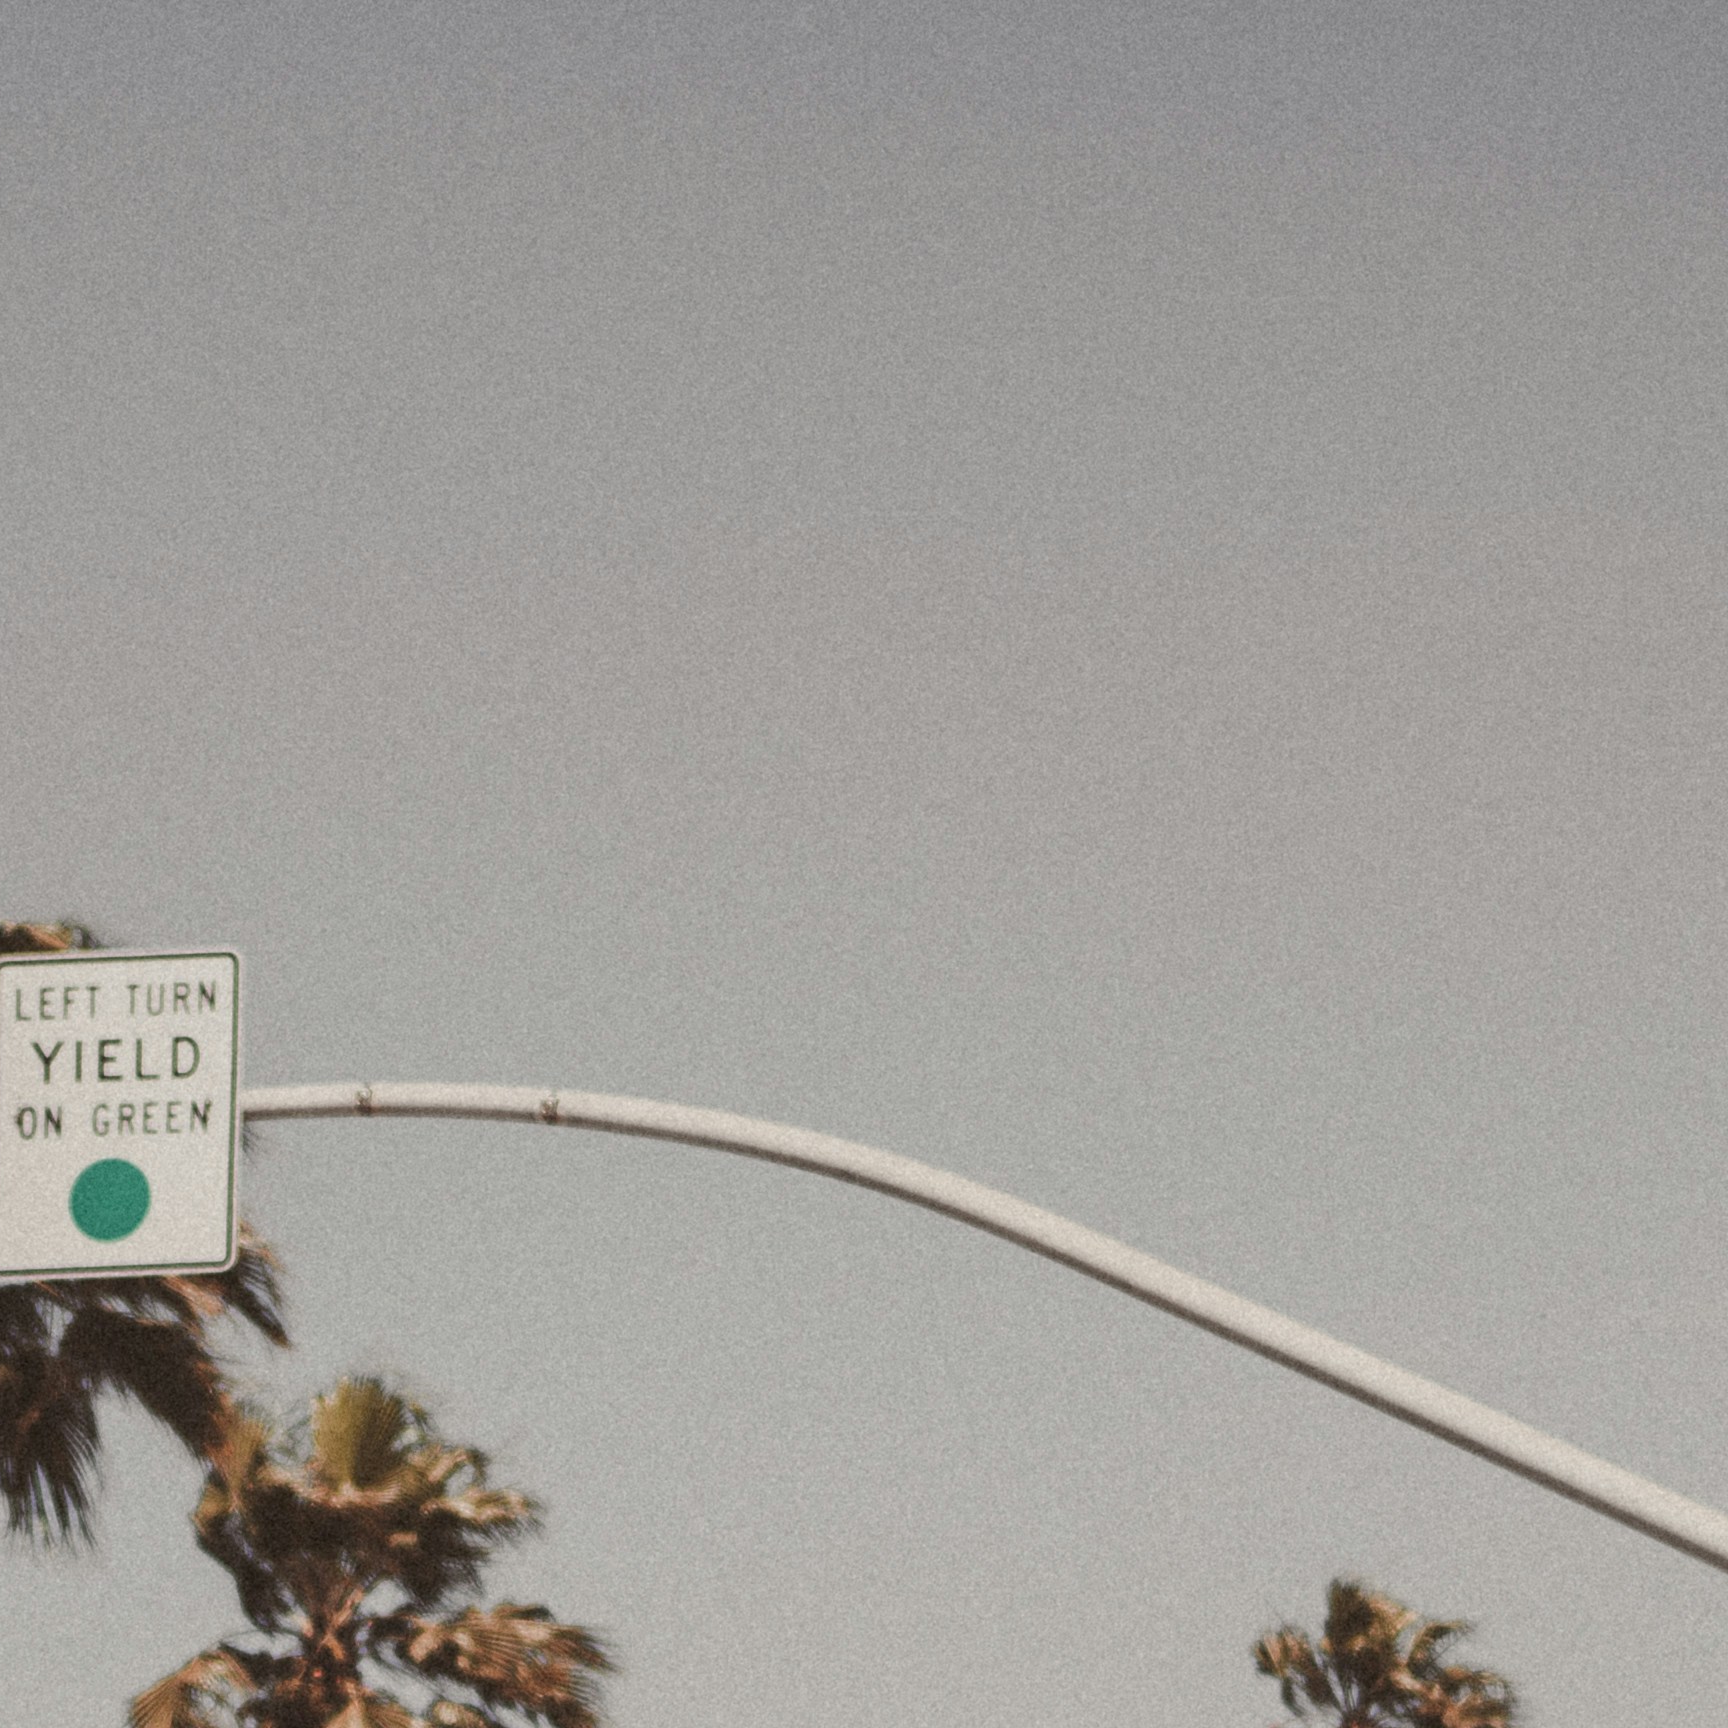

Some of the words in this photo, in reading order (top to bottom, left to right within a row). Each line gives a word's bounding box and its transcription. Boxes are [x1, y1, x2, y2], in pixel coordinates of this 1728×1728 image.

[15, 986, 101, 1021] LEFT
[127, 980, 217, 1017] TURN
[32, 1036, 201, 1084] YIELD
[16, 1105, 63, 1140] ON
[92, 1100, 212, 1137] GREEN
